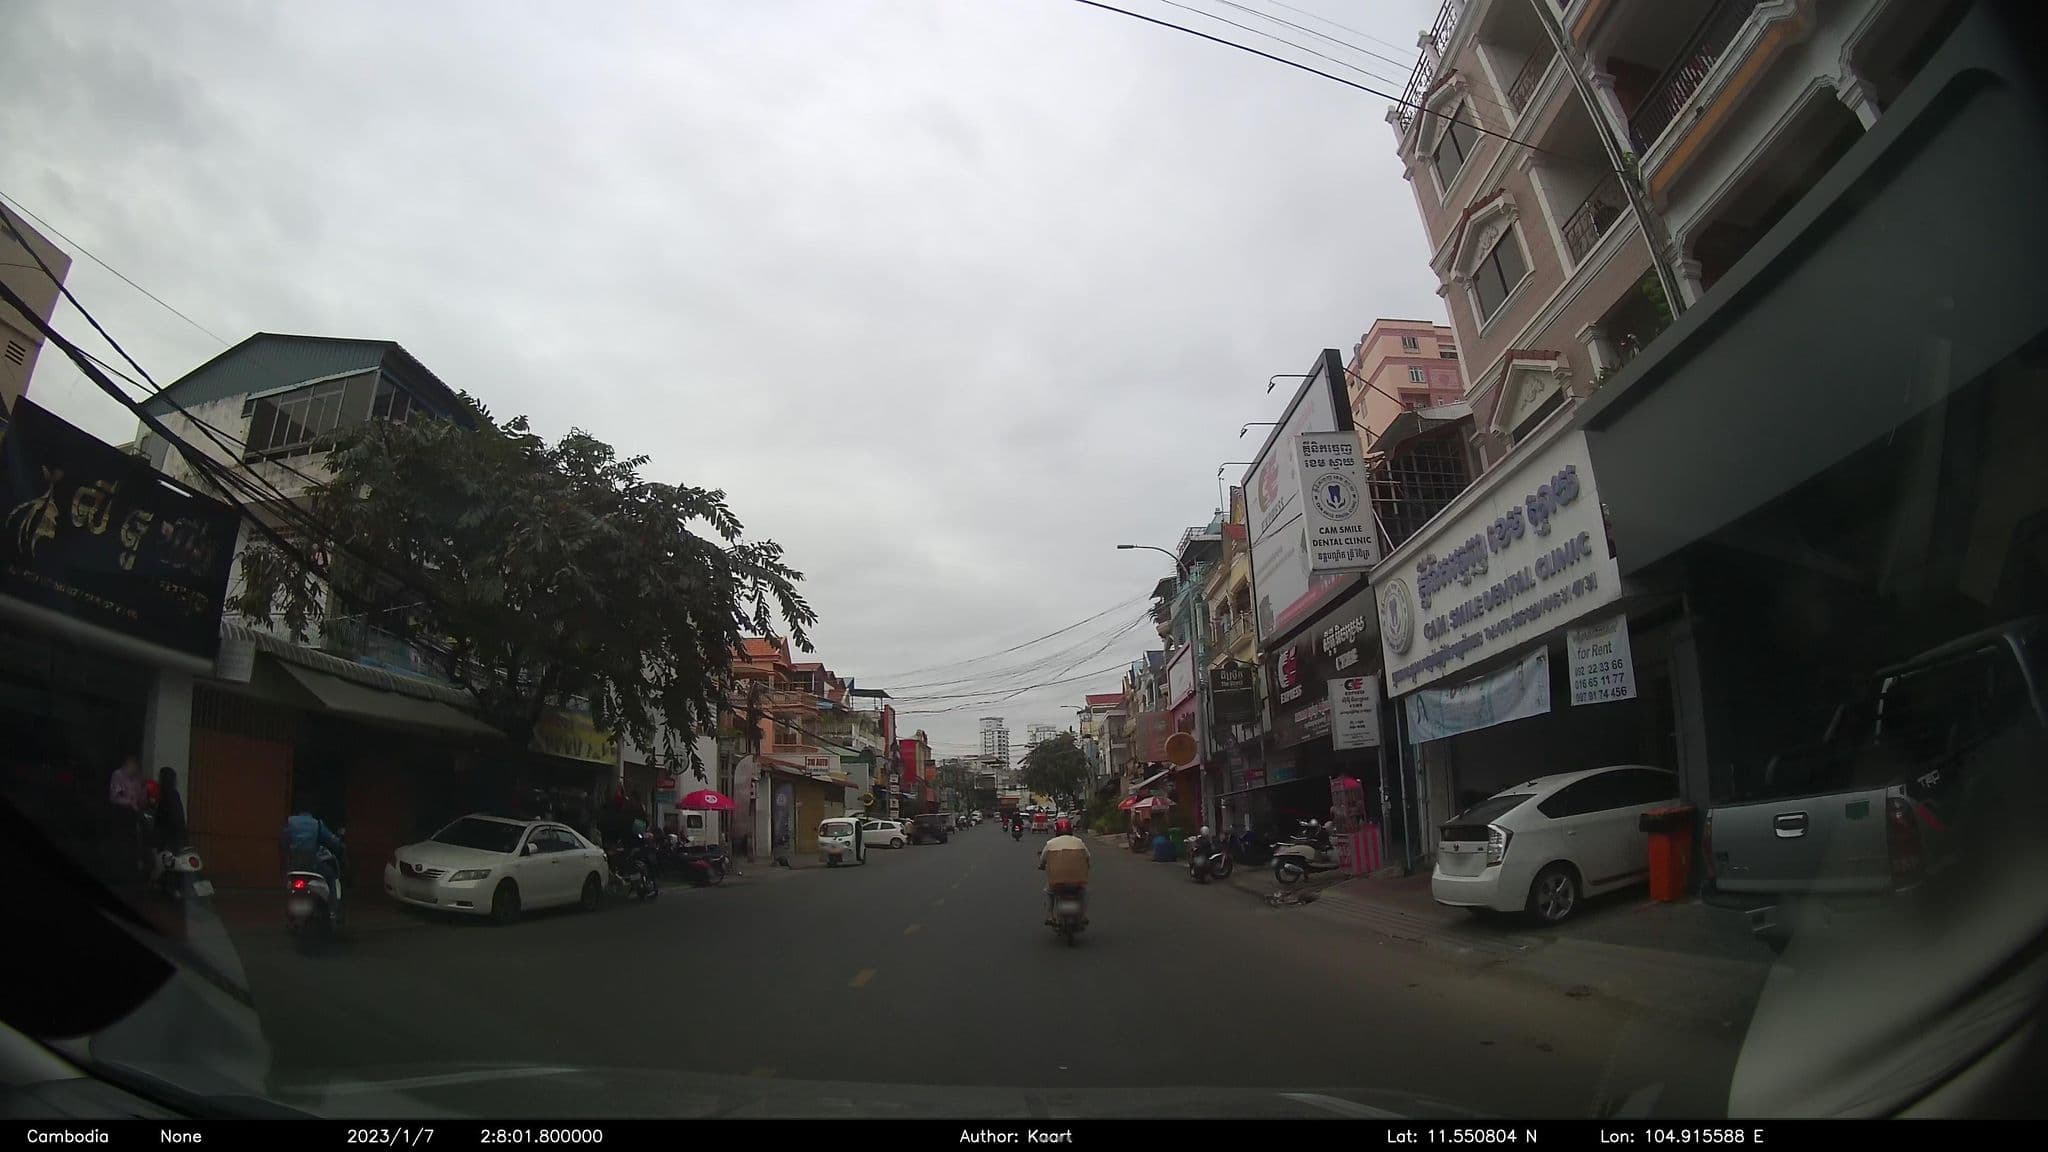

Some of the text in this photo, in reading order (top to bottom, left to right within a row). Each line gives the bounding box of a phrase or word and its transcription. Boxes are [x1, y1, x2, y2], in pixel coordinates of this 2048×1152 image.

[1319, 525, 1363, 535] CAM SMILE
[1312, 536, 1372, 547] DENTAL CLINIC
[1534, 530, 1592, 581] CLINIC
[1577, 640, 1613, 660] for Rent
[1587, 664, 1598, 674] 22
[1599, 661, 1610, 672] 33
[1611, 658, 1623, 670] 66
[1600, 675, 1611, 685] 11
[1612, 672, 1625, 683] 77
[1610, 686, 1628, 698] 456
